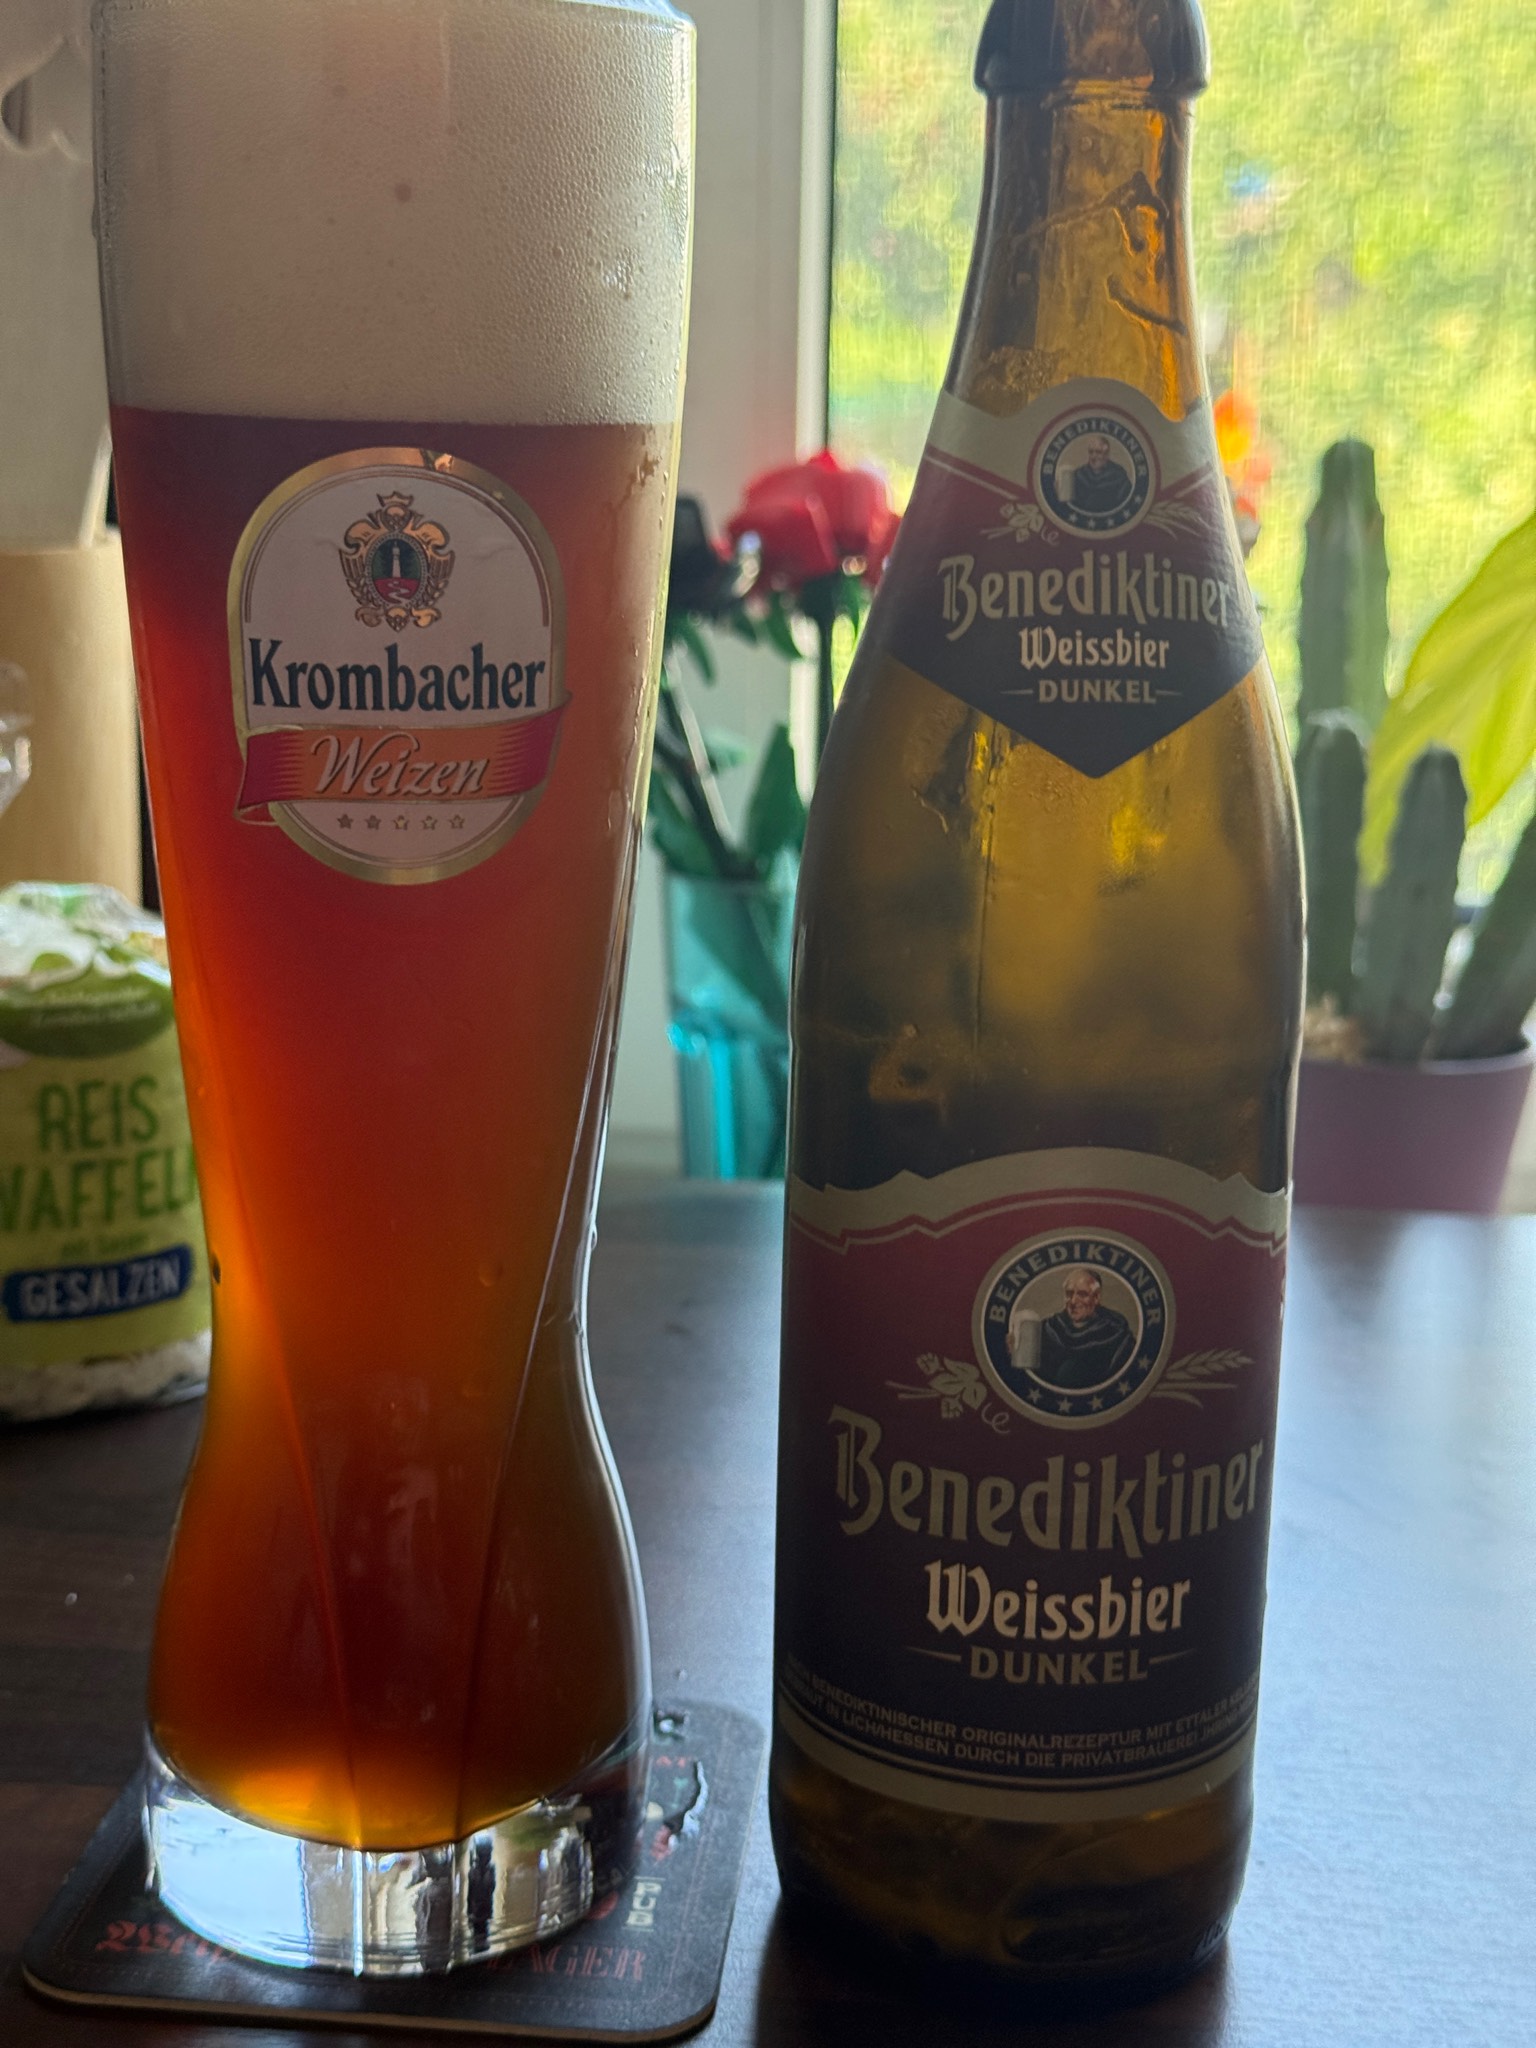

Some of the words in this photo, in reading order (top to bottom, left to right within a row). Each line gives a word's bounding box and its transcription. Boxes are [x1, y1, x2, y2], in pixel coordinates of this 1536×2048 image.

[1043, 418, 1148, 479] BENEDIKTINER
[938, 549, 1231, 641] Benediktiner
[249, 637, 545, 711] Krombacher
[1018, 626, 1170, 669] Weissbier
[1038, 679, 1157, 704] DUNKEL
[311, 732, 490, 796] Weizen
[38, 1074, 159, 1149] REIS
[20, 1254, 181, 1316] GESALZEN
[988, 1243, 1162, 1326] BENEDIKTINER
[828, 1404, 1265, 1559] Benediktiner
[924, 1559, 1191, 1640] Weissbier
[969, 1646, 1148, 1685] DUNKEL
[954, 1742, 1019, 1766] DURCH
[1025, 1751, 1055, 1768] DIE
[1146, 1721, 1172, 1741] MIT
